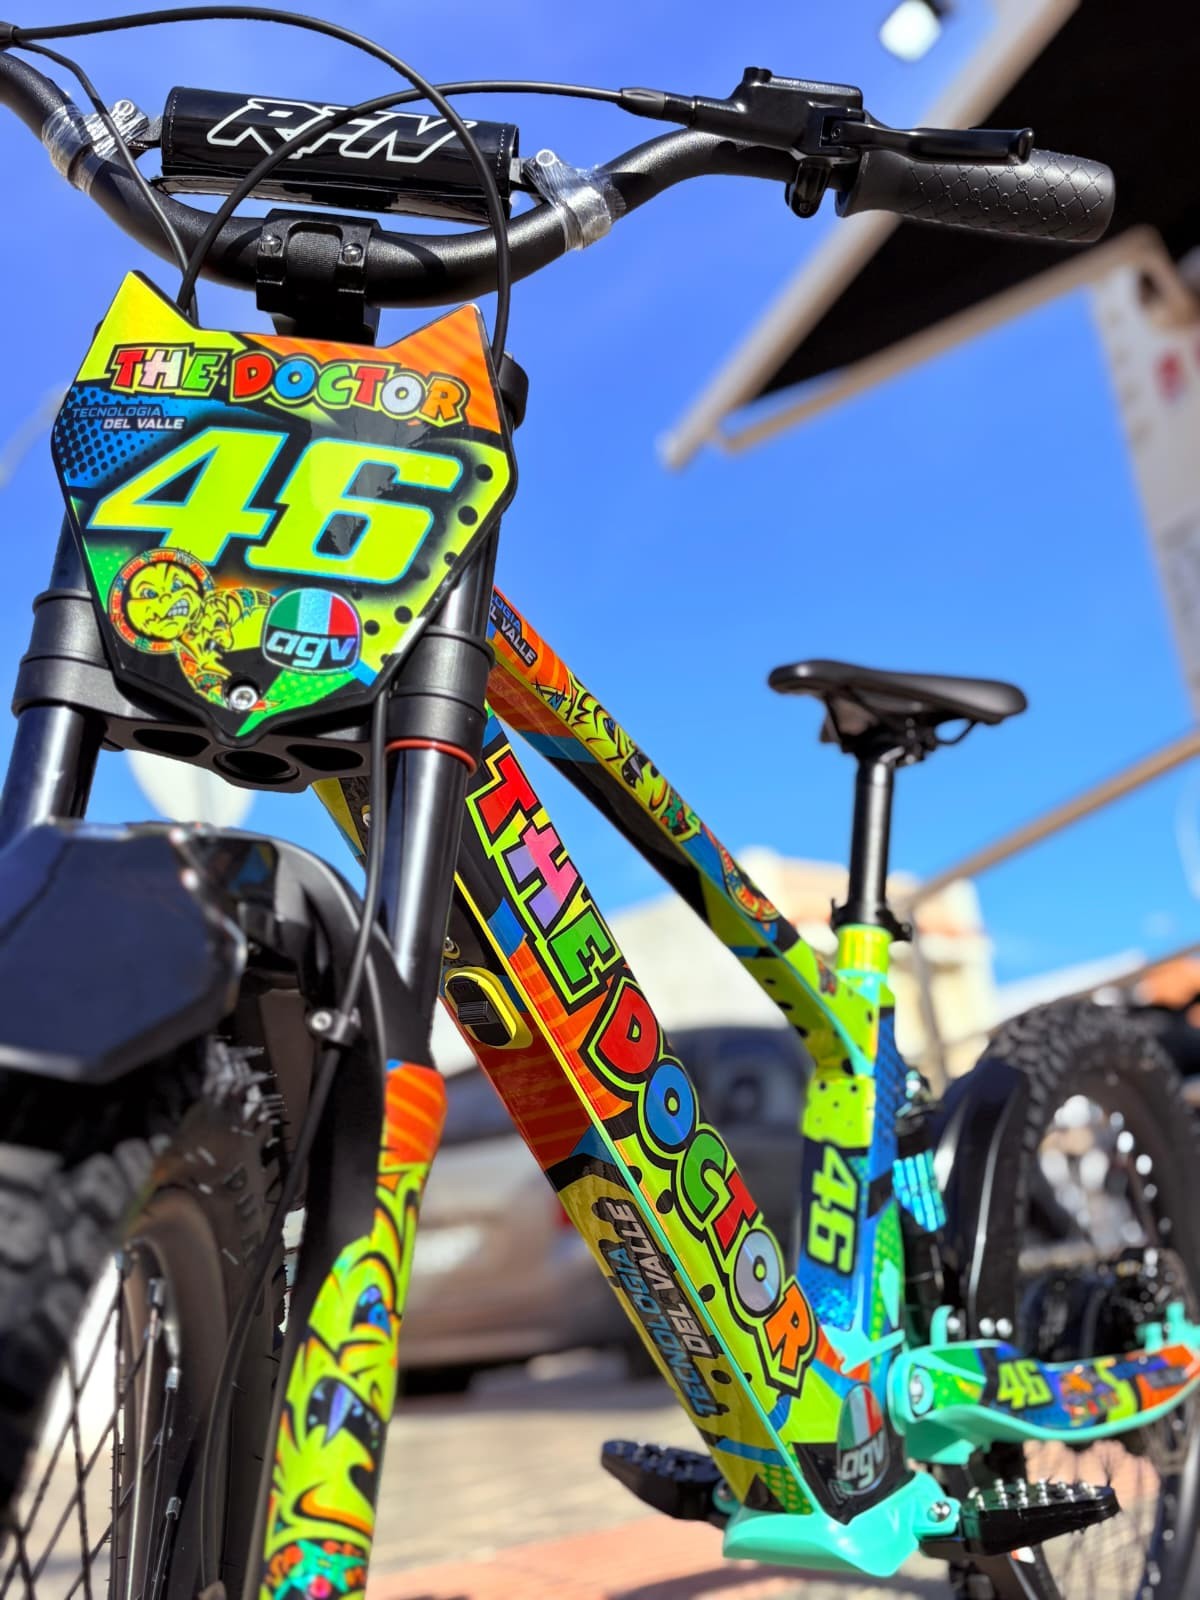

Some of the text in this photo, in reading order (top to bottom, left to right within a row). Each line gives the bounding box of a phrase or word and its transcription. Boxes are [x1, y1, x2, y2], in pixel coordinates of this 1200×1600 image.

[72, 406, 161, 418] TECNOLOGIA
[103, 418, 185, 430] DEL VALLE
[112, 347, 467, 423] THE DOCTOR
[86, 426, 464, 584] 46
[501, 617, 537, 665] VALLE
[477, 752, 811, 1380] THE DOCTOR
[807, 1147, 859, 1273] 46
[605, 1201, 713, 1356] DEL VALLE
[608, 1246, 707, 1414] TECNOLOGIA
[997, 1359, 1052, 1410] 46
